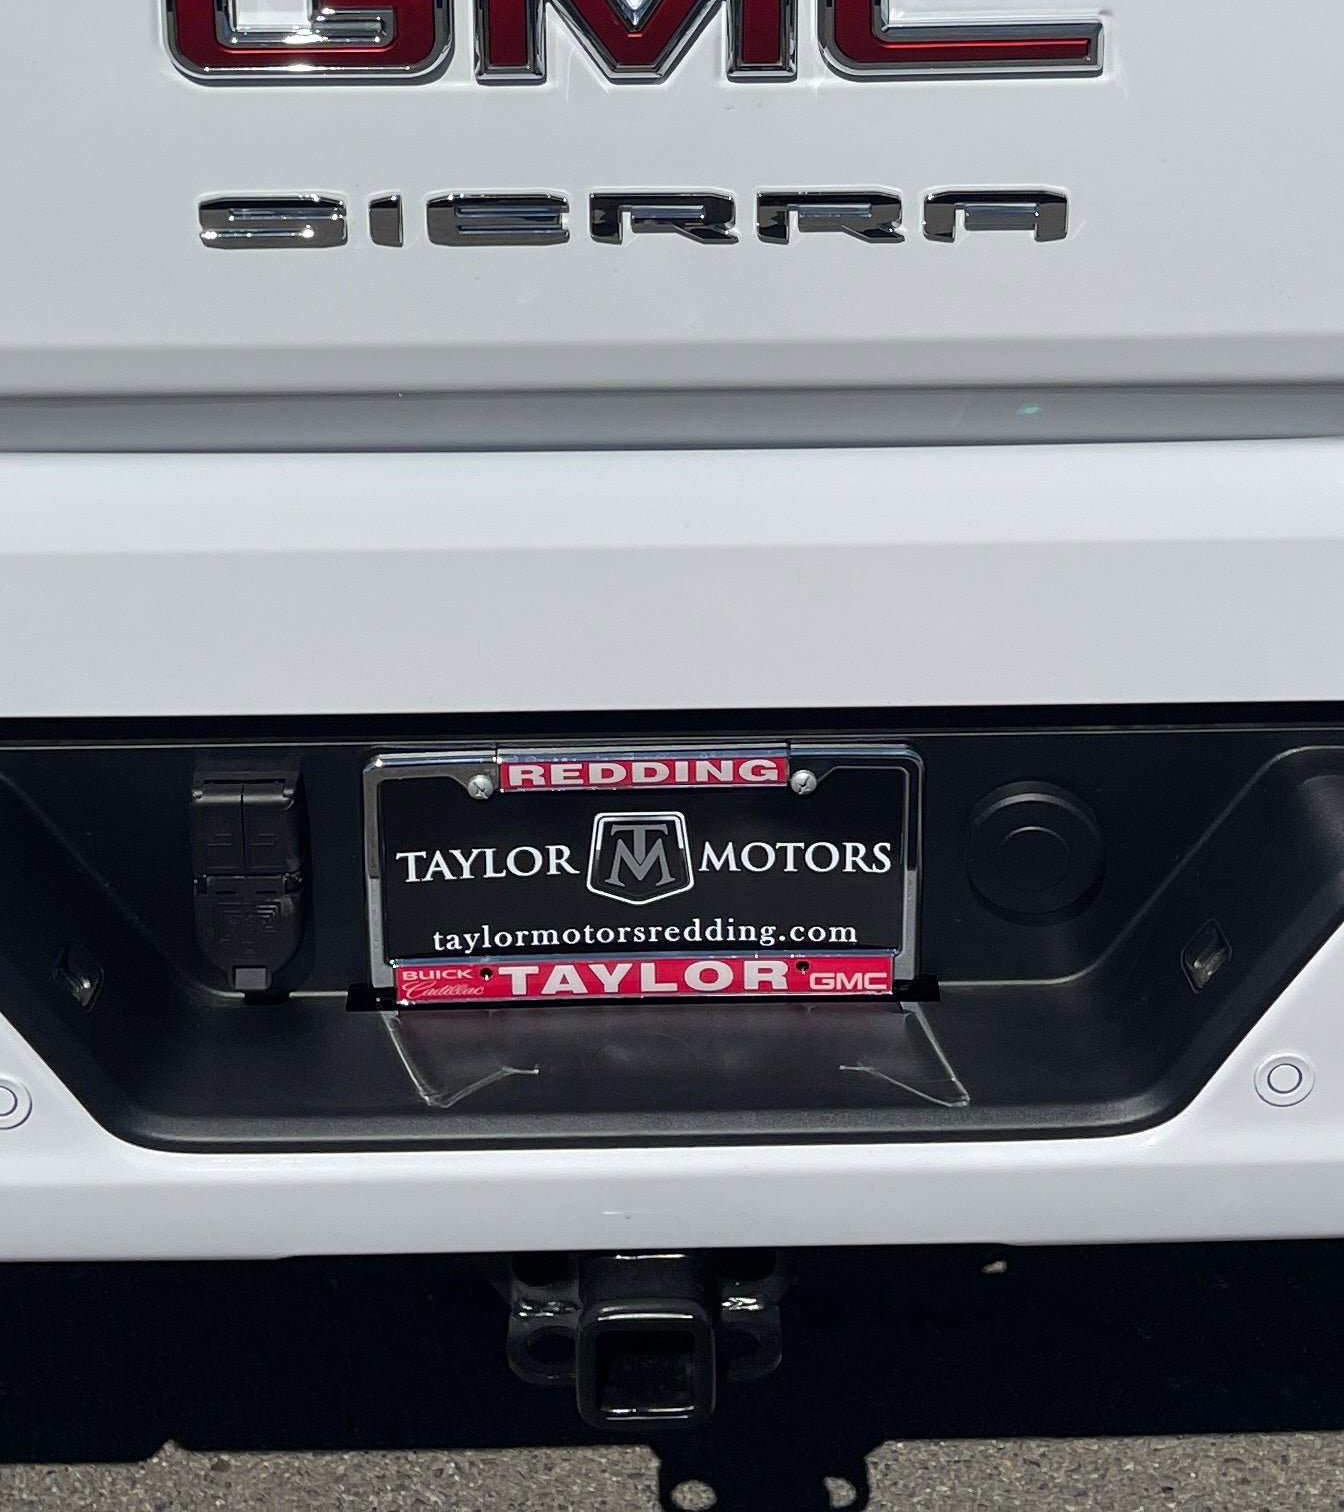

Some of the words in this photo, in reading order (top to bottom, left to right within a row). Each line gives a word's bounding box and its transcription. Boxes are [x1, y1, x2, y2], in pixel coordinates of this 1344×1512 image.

[197, 188, 1069, 249] SIERRA
[509, 758, 780, 787] REDDING
[396, 845, 580, 884] TAYLOR
[699, 841, 892, 874] MOTORS
[432, 918, 858, 954] taylormotorsredding.com
[401, 968, 474, 981] BUICK
[402, 981, 485, 999] Cadillac
[498, 960, 790, 996] TAYLOR
[809, 972, 888, 991] GMC
